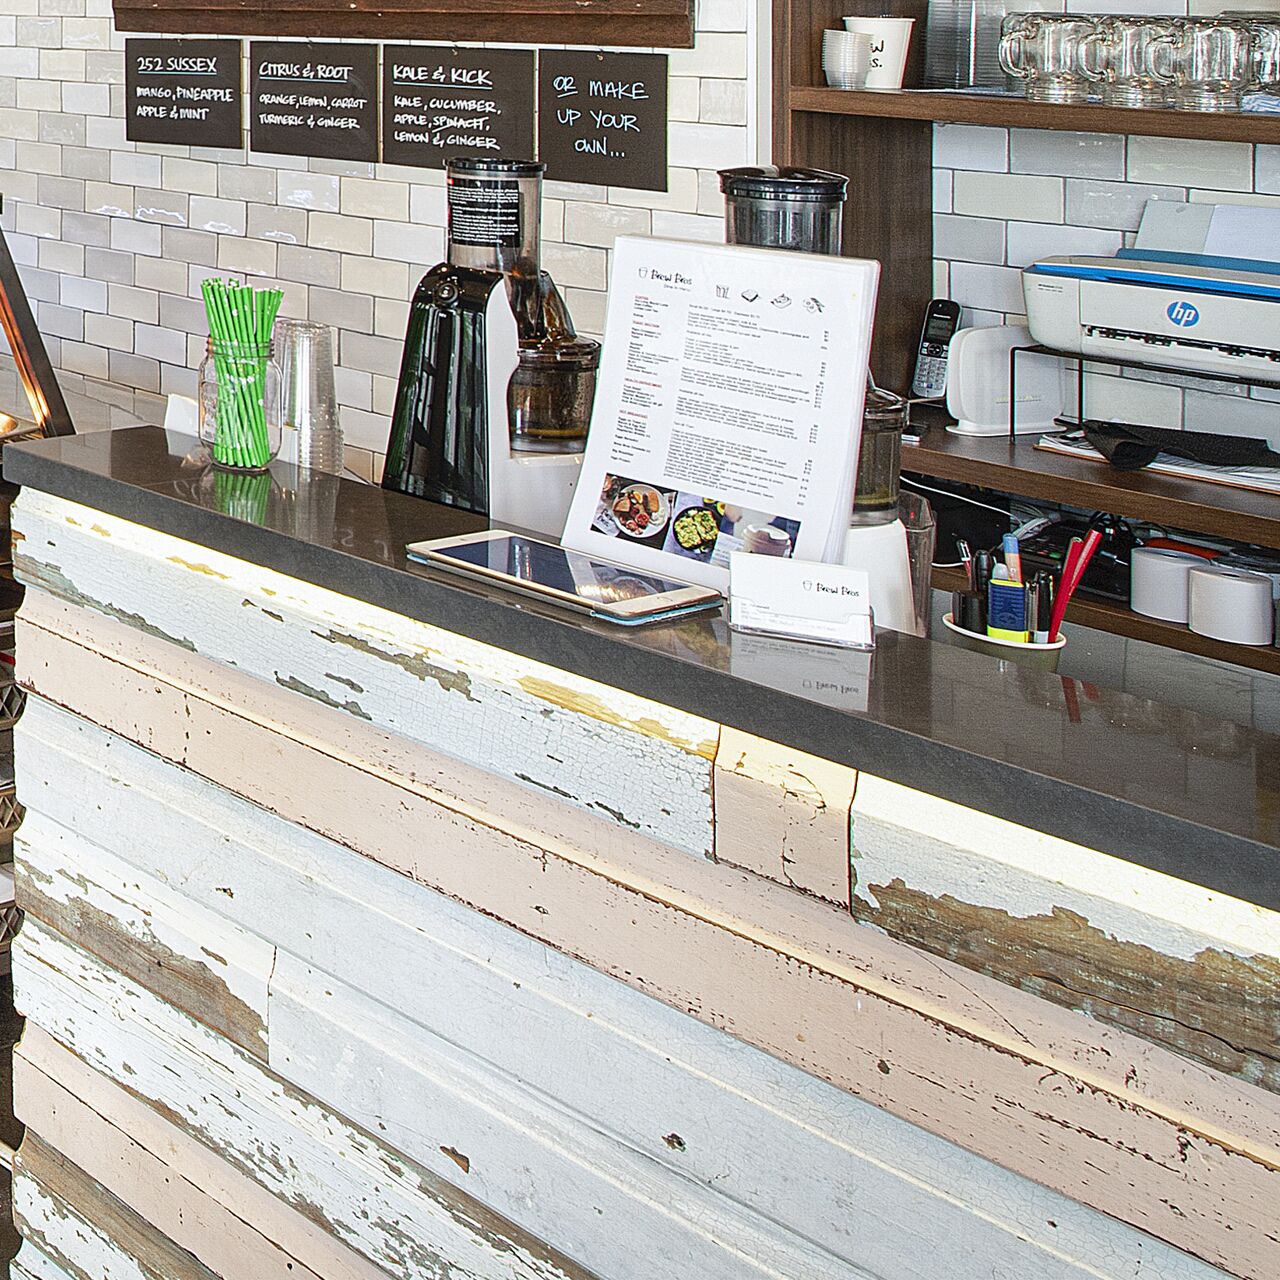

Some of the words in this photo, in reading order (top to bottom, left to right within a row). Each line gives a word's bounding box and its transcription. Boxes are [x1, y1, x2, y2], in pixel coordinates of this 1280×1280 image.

[137, 57, 163, 71] 252
[166, 56, 218, 72] SUSSEX
[258, 61, 300, 77] CITRUS
[302, 63, 314, 79] &
[317, 65, 353, 80] ROOT
[393, 64, 428, 81] KALE
[431, 66, 446, 83] &
[450, 68, 493, 85] KICK
[176, 88, 234, 103] PINEAPPLE
[553, 76, 577, 91] OR
[589, 80, 649, 99] MAKE
[331, 96, 368, 110] CARROT
[136, 105, 167, 118] APPLE
[179, 108, 210, 120] MINT
[556, 109, 582, 126] UP
[590, 109, 640, 132] YOUR
[259, 114, 304, 126] TURMERIC
[307, 115, 316, 128] &
[317, 117, 360, 130] GINGER
[394, 131, 429, 144] LEMON
[432, 131, 444, 147] &
[446, 135, 500, 150] GINGER
[651, 269, 672, 281] Brew
[1171, 301, 1198, 327] hp
[816, 582, 838, 594] Brew
